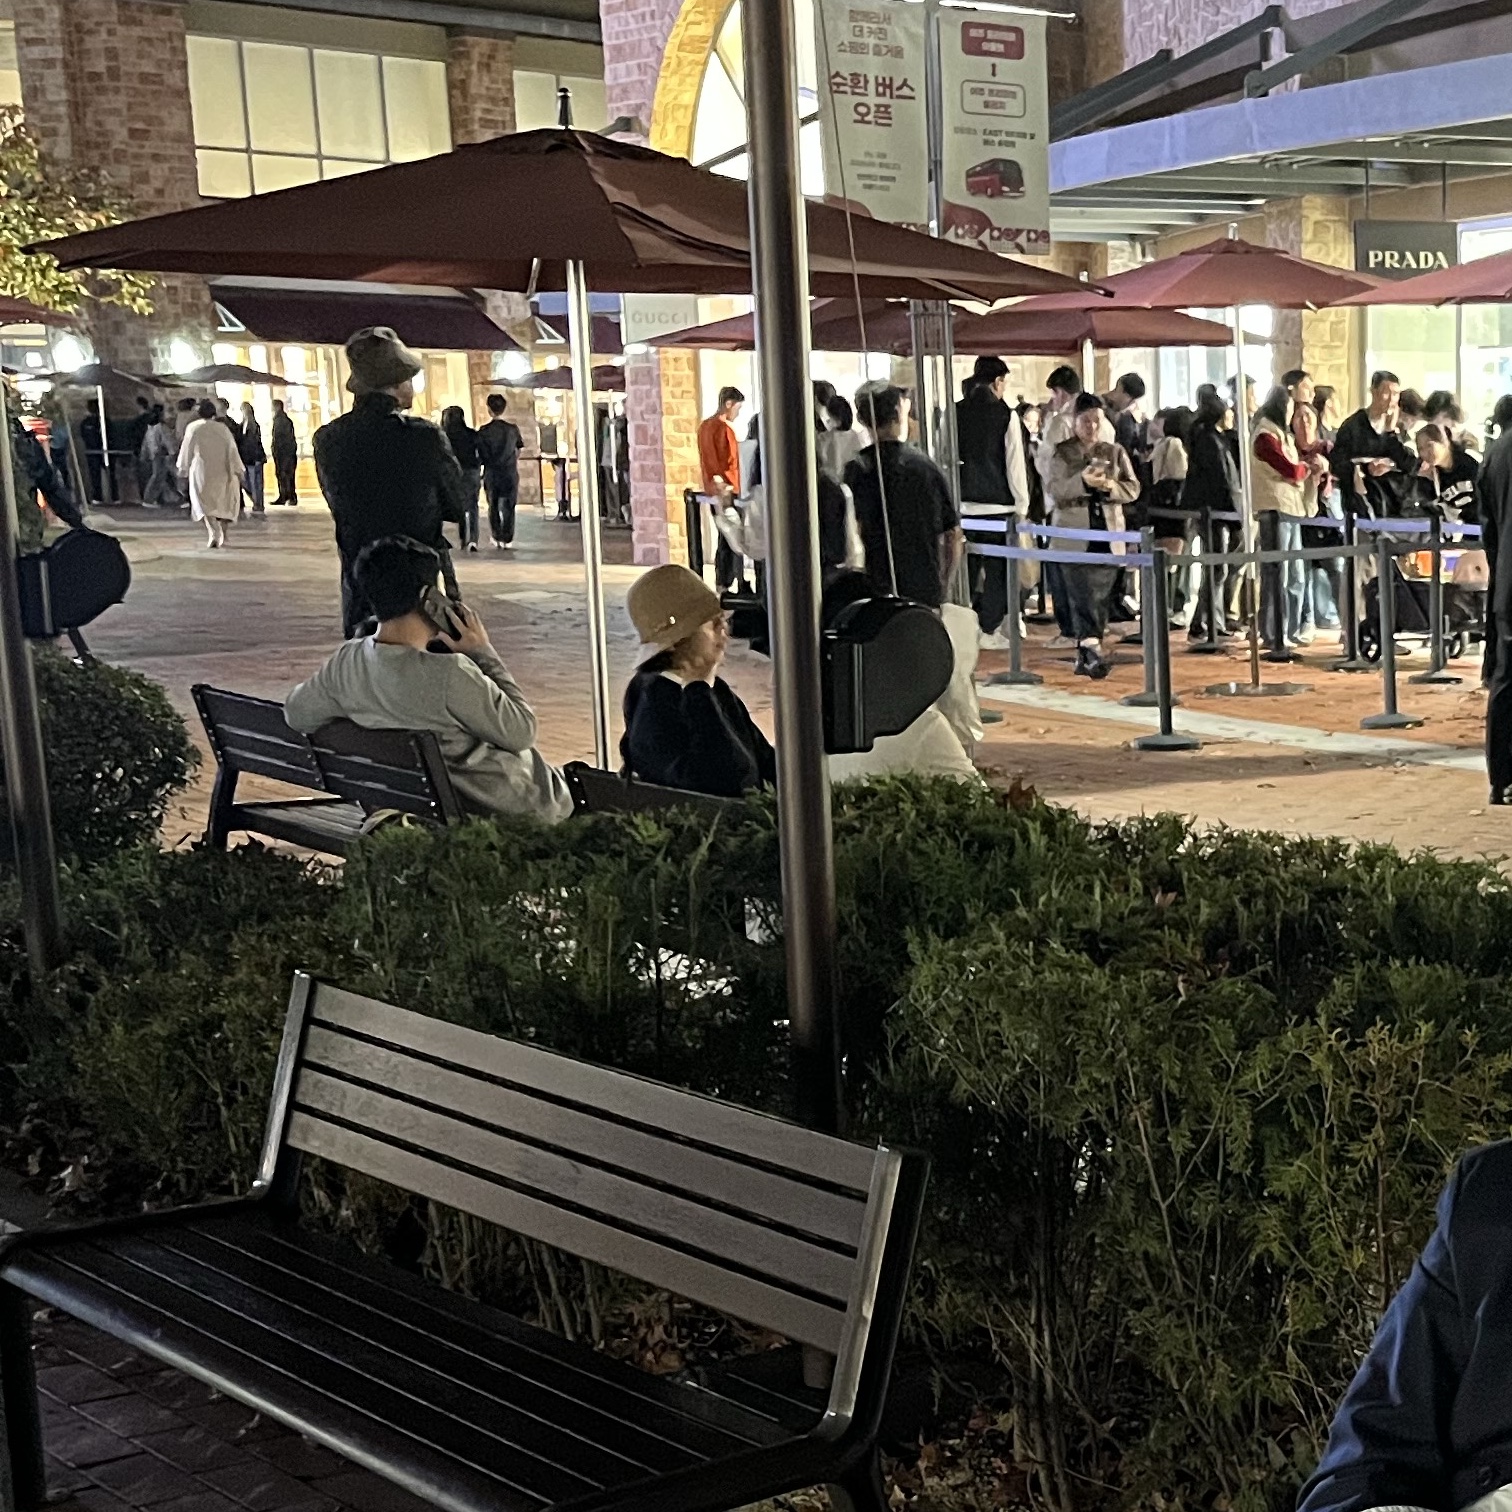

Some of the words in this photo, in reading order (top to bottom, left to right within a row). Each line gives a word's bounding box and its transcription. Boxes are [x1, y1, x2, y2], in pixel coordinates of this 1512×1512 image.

[831, 70, 870, 98] 순환
[874, 74, 916, 101] 버스
[852, 101, 893, 128] 오픈
[1368, 249, 1449, 269] PRADA
[631, 310, 689, 326] GUCCI
